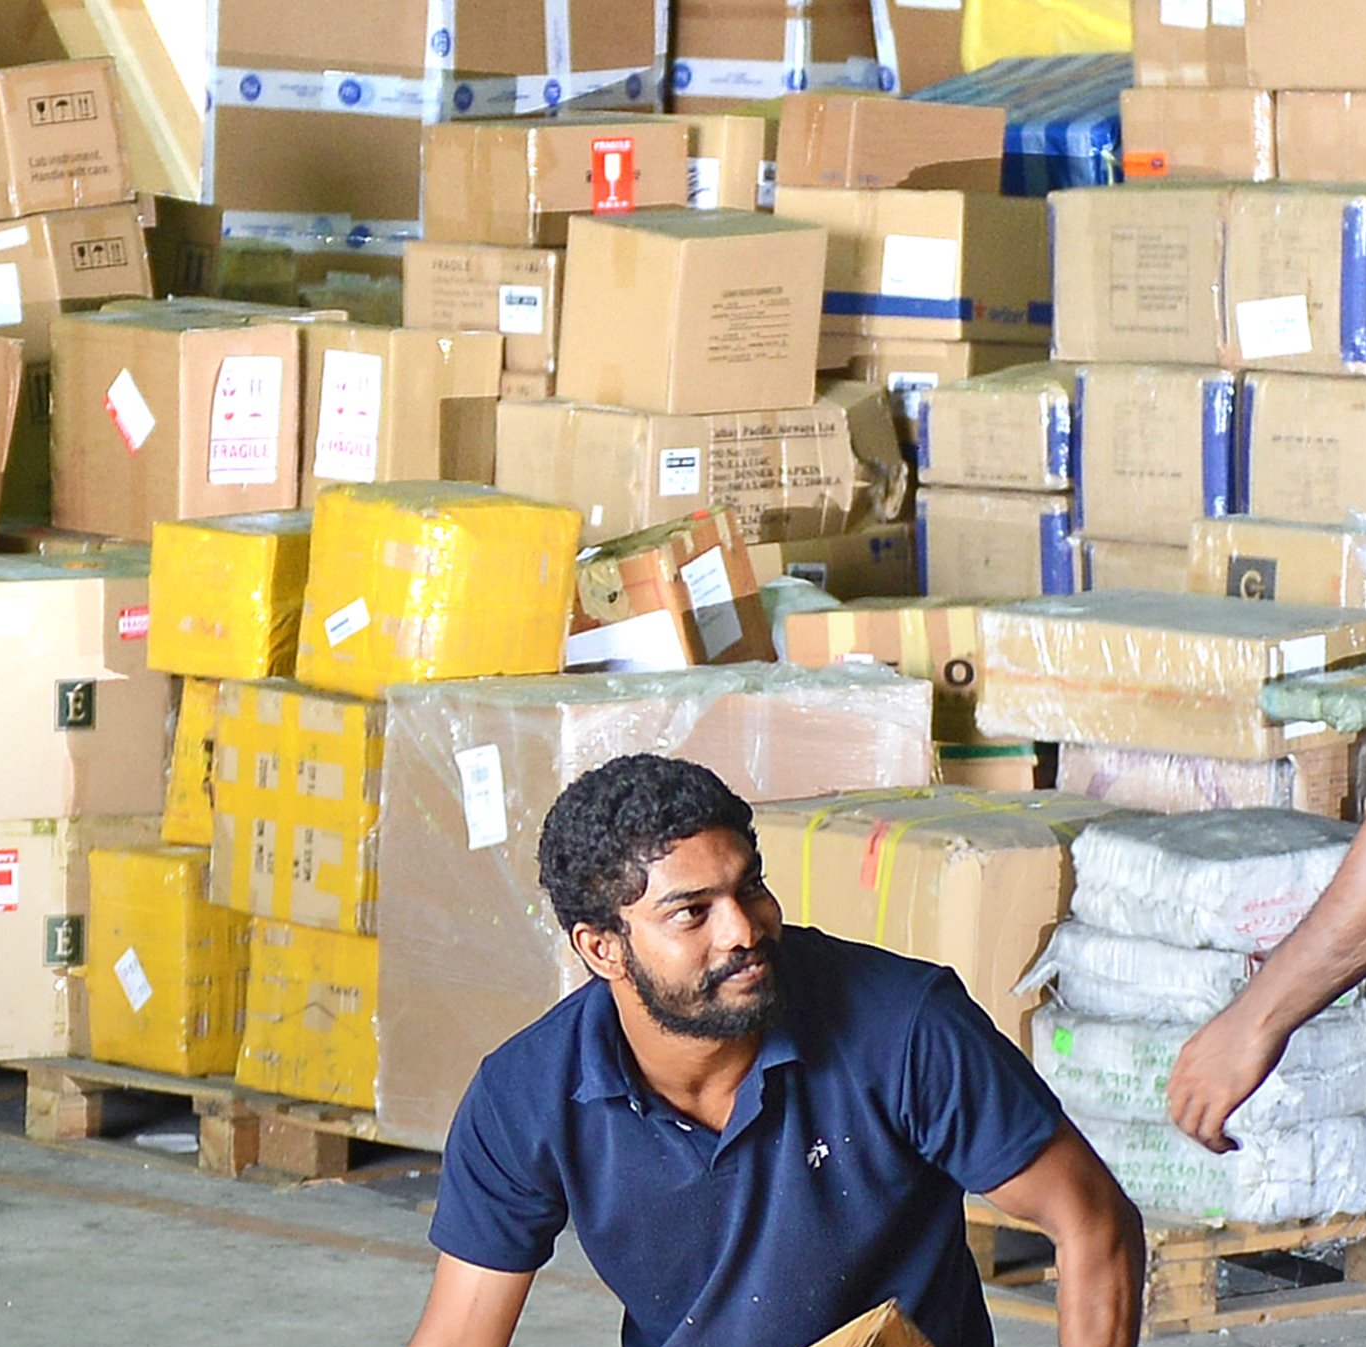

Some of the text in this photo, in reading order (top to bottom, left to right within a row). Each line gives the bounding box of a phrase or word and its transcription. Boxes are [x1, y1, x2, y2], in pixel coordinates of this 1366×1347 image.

[212, 444, 271, 459] FRAGILE
[65, 682, 84, 722] É
[54, 918, 74, 956] É
